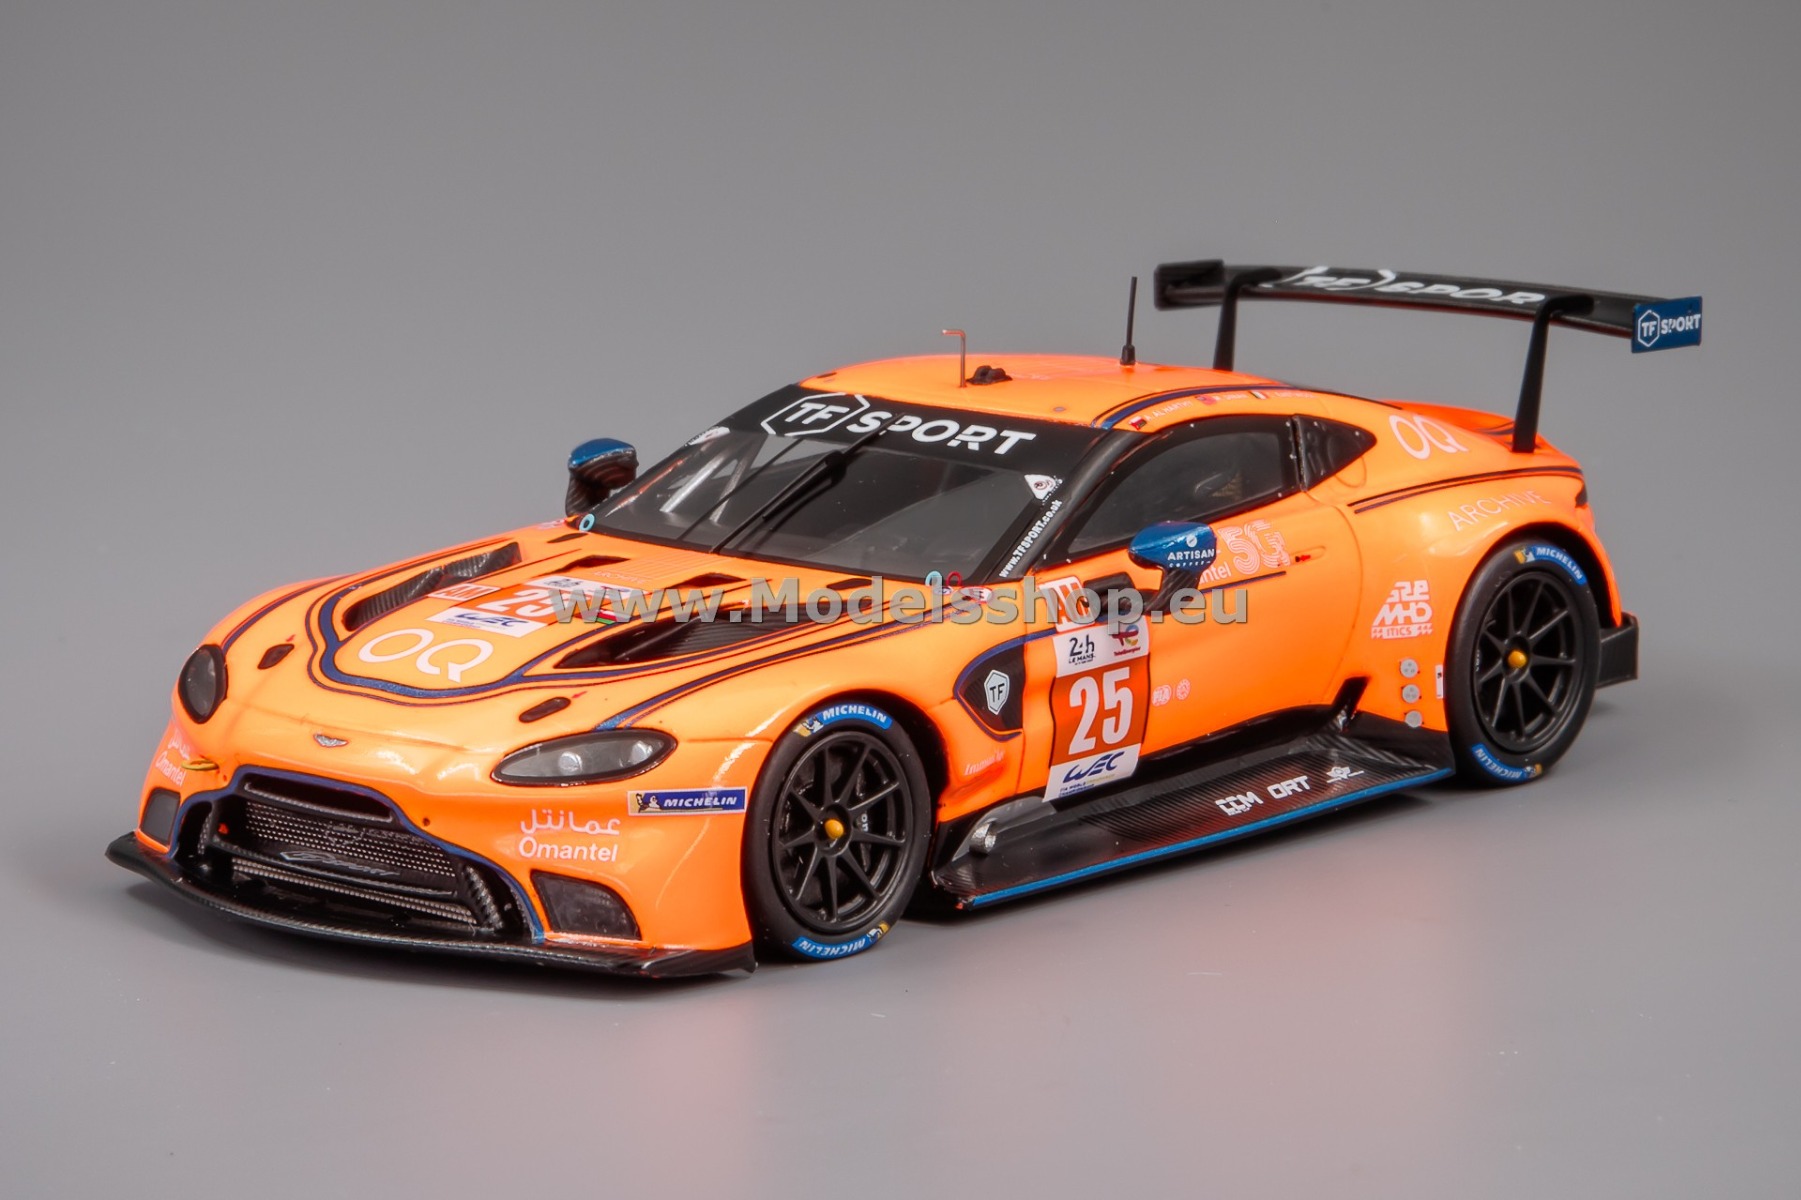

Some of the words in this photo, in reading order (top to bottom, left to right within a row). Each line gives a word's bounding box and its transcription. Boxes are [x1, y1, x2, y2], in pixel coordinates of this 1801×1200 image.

[1374, 281, 1546, 304] SPOR
[1641, 320, 1657, 338] TF
[1660, 313, 1702, 335] SPORT
[784, 402, 851, 425] TF
[846, 411, 1037, 455] SPORT
[1388, 414, 1469, 460] OQ
[1447, 489, 1552, 532] ARCHIVE
[998, 499, 1063, 578] www.TFSPORT.co.uk
[1217, 518, 1291, 575] 5G
[1167, 548, 1215, 561] ARTISAN
[1536, 546, 1583, 580] MICHELIN
[1199, 560, 1232, 585] ntel
[1372, 601, 1433, 627] MHD
[358, 628, 494, 684] OQ
[989, 682, 1006, 703] TF
[822, 704, 888, 724] MICHELIN
[1067, 666, 1134, 755] 25
[1062, 751, 1126, 784] WEC
[1266, 775, 1311, 800] ORT
[663, 796, 738, 809] MICHELIN
[520, 808, 621, 836] عمانتل
[518, 836, 618, 862] Omantel
[798, 938, 867, 957] MICHELIN
